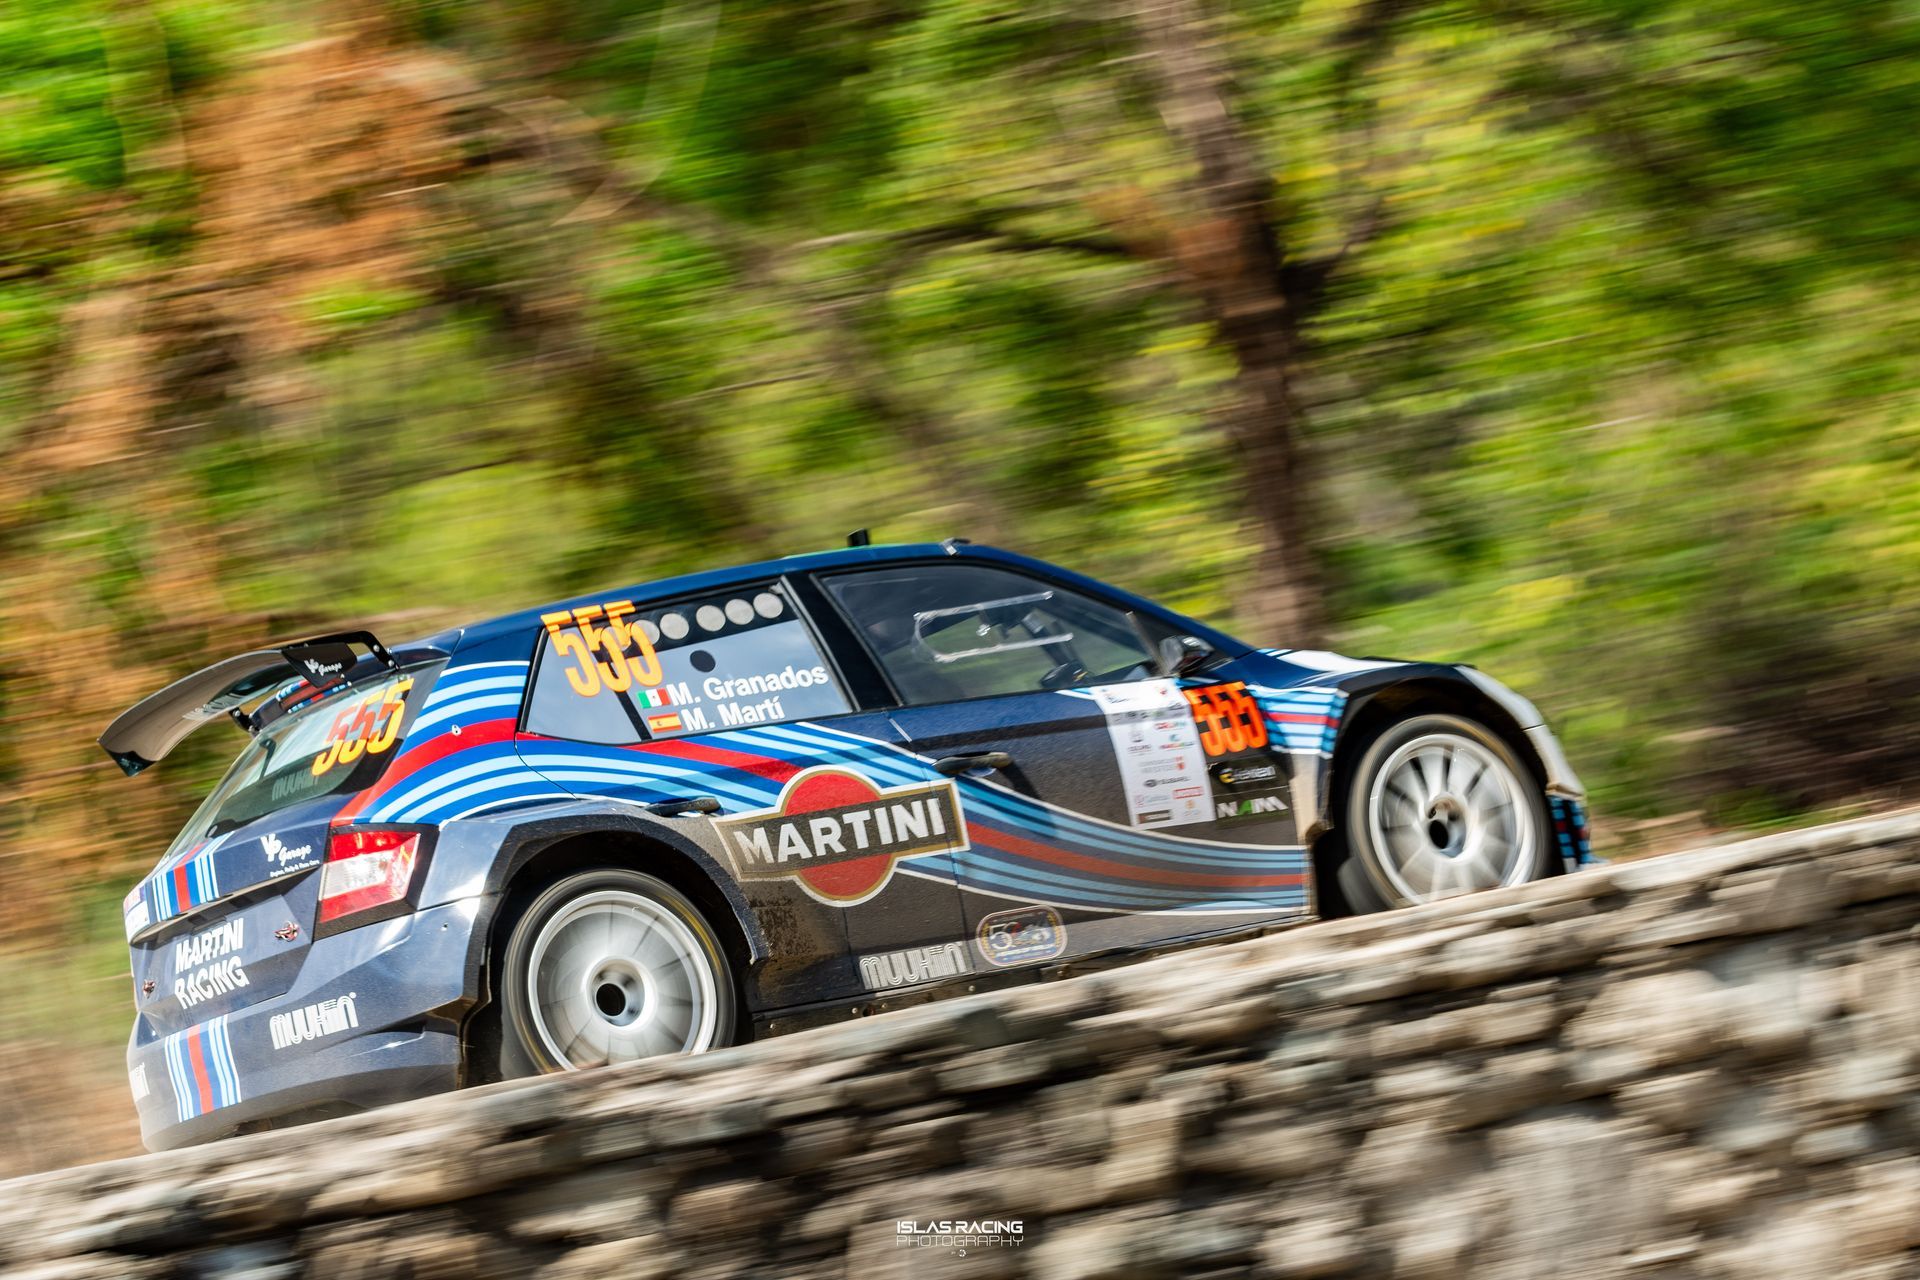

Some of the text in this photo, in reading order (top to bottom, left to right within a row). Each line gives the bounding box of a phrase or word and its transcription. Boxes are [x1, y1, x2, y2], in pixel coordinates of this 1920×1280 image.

[541, 600, 663, 697] 555
[665, 665, 829, 706] M. Granados
[681, 696, 786, 732] M. Martí
[311, 678, 415, 776] 555
[1182, 681, 1269, 757] 555
[733, 798, 946, 866] MARTINI
[175, 917, 245, 974] MARTINI
[174, 955, 250, 1010] RACING
